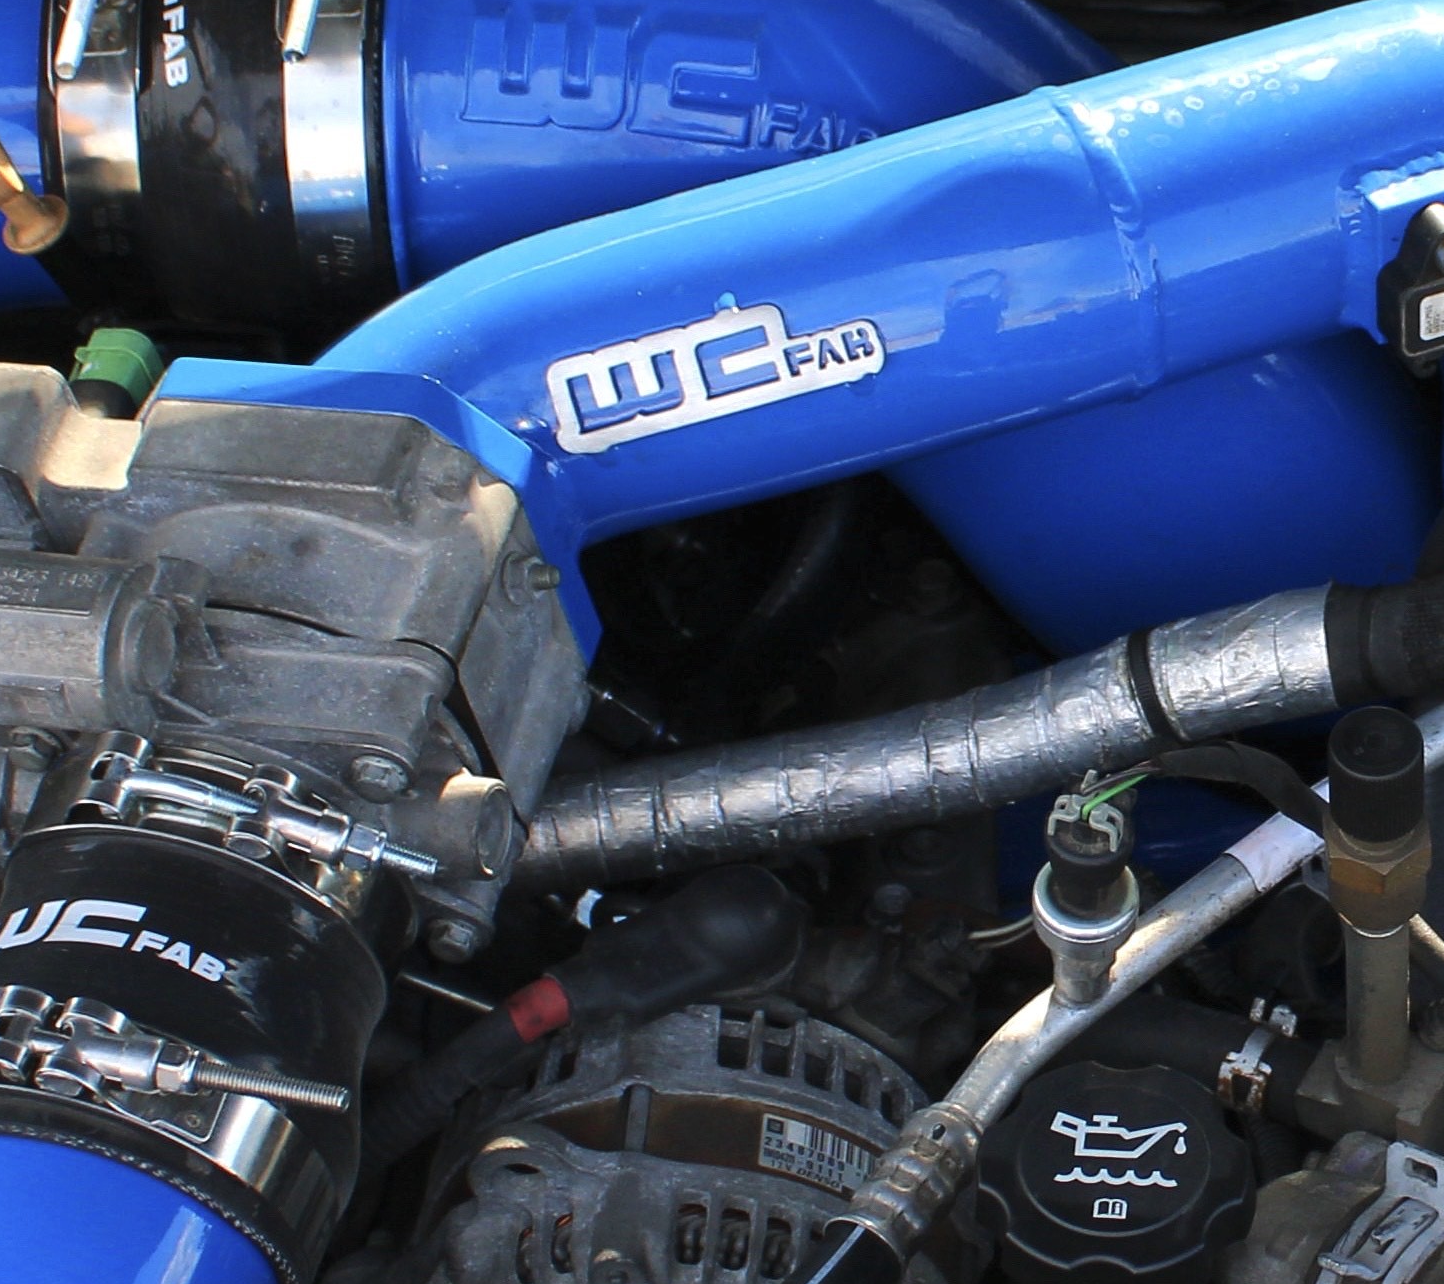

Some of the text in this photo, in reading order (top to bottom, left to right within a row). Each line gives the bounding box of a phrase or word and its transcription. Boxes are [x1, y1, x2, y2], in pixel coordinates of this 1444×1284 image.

[162, 5, 189, 87] FAB
[566, 324, 875, 435] WC FAB
[129, 929, 228, 983] FAB
